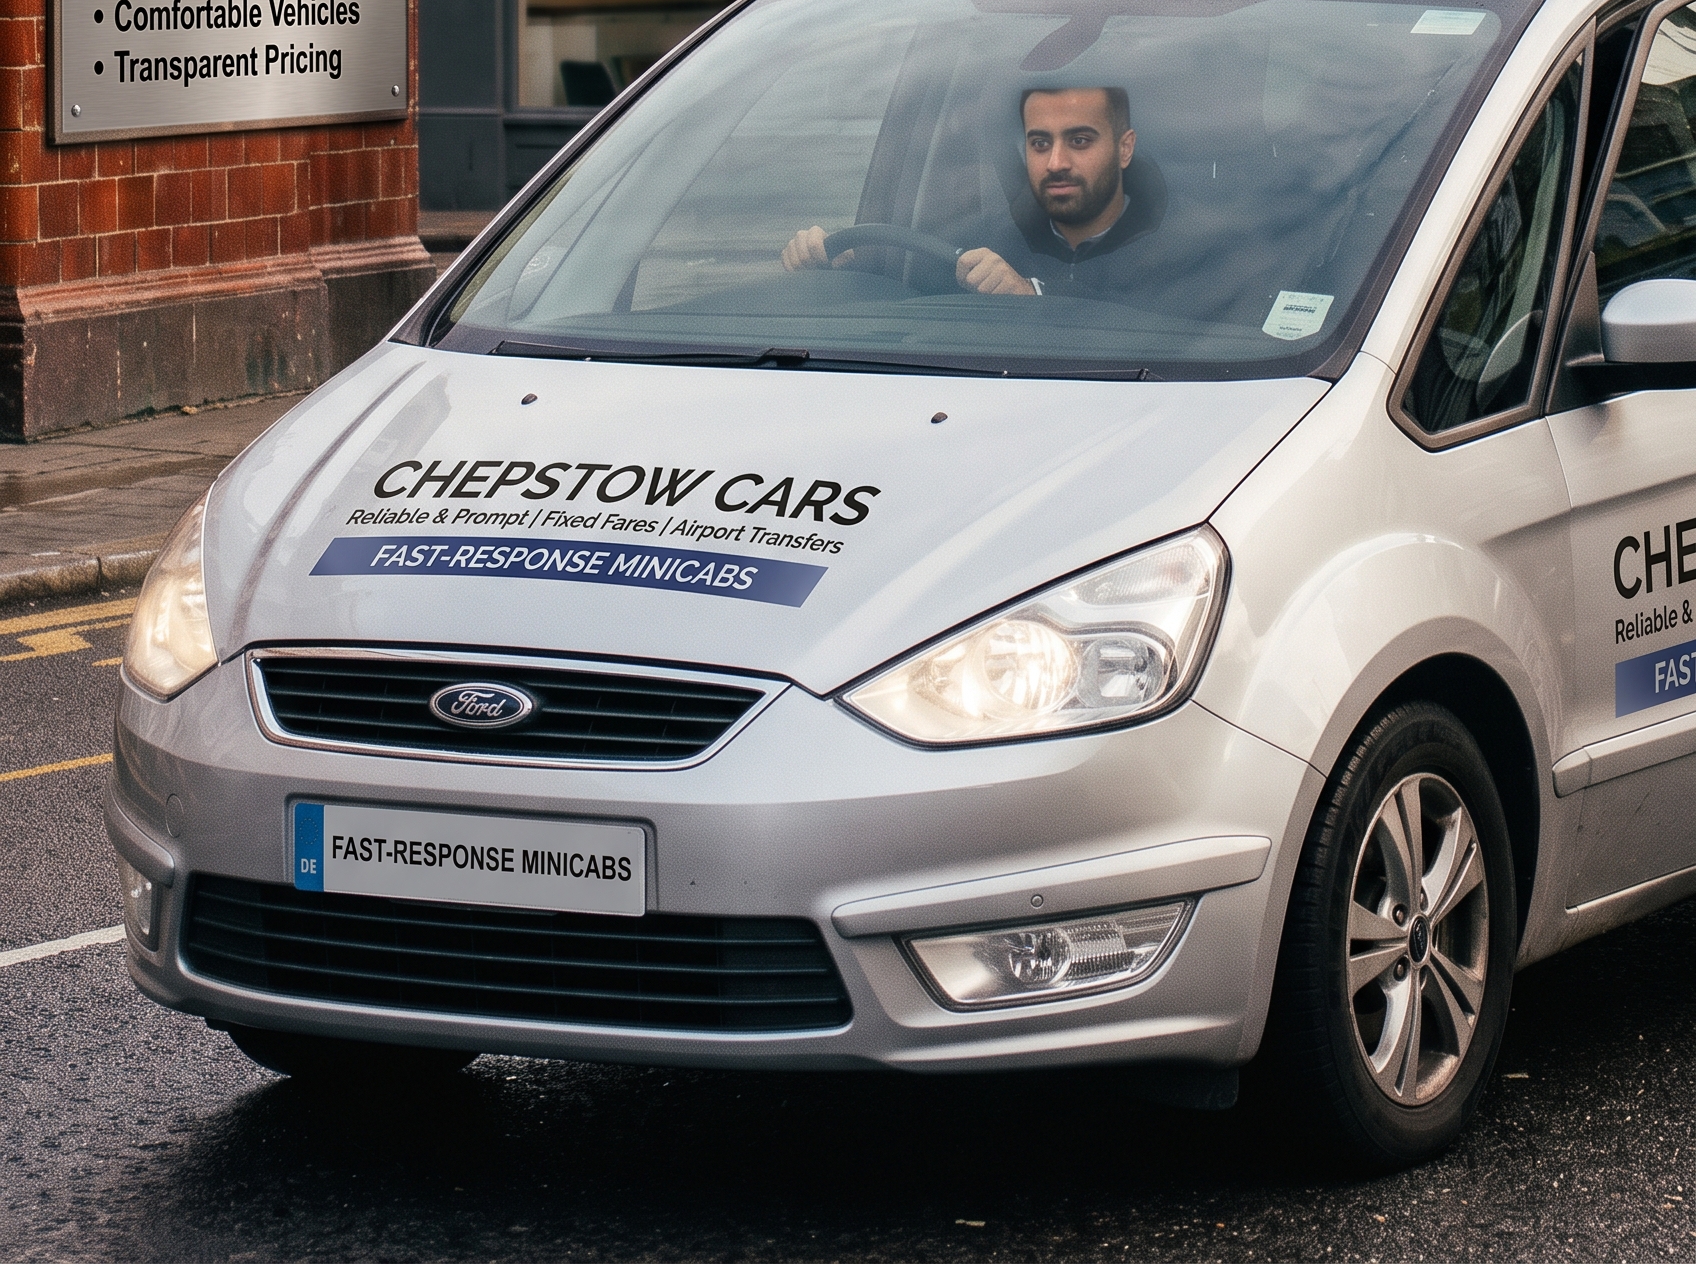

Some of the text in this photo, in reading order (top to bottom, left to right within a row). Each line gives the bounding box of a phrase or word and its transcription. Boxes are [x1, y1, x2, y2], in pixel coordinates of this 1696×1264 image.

[114, 43, 342, 87] Transparent Pricing
[373, 459, 882, 526] CHEPSTOW CARS
[345, 507, 431, 525] Reliable
[432, 508, 450, 524] &
[451, 508, 530, 529] Prompt
[541, 510, 603, 529] Fixed
[600, 513, 659, 533] Fares
[669, 519, 746, 542] Airport
[749, 526, 845, 554] Transfers
[370, 544, 759, 590] FAST-RESPONSE MINICABS
[1615, 599, 1693, 645] Reliable &
[451, 690, 504, 718] Ford
[300, 858, 317, 875] DE
[332, 835, 632, 882] FAST-RESPONSE MINICABS
